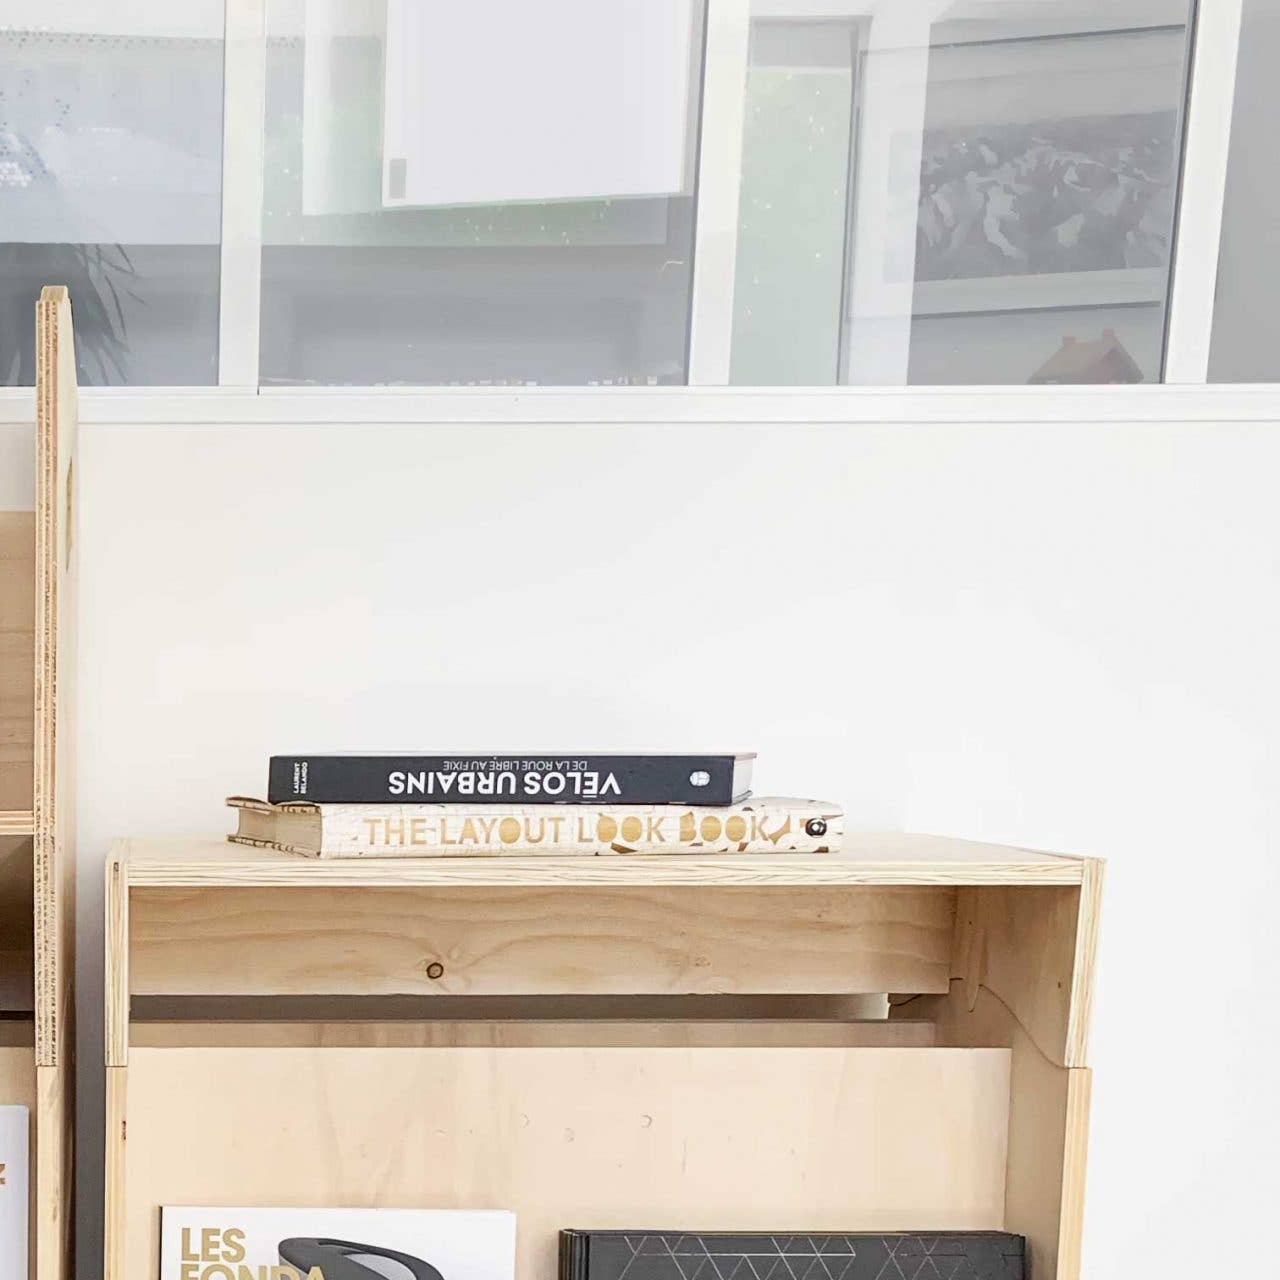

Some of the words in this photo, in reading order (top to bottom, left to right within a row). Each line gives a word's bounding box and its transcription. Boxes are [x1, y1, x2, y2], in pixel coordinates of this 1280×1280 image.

[443, 761, 468, 771] FIXIE
[470, 761, 488, 771] AU
[489, 761, 520, 771] LIBRE
[522, 761, 552, 771] ROUE
[554, 761, 570, 771] LA
[572, 761, 588, 771] DE
[388, 771, 517, 795] URBAINS
[523, 771, 621, 798] VÉLOS
[363, 817, 427, 845] THE
[440, 816, 566, 845] LAYOUT
[578, 815, 666, 843] LOOK
[680, 812, 769, 842] BOOK
[180, 1227, 247, 1264] LES
